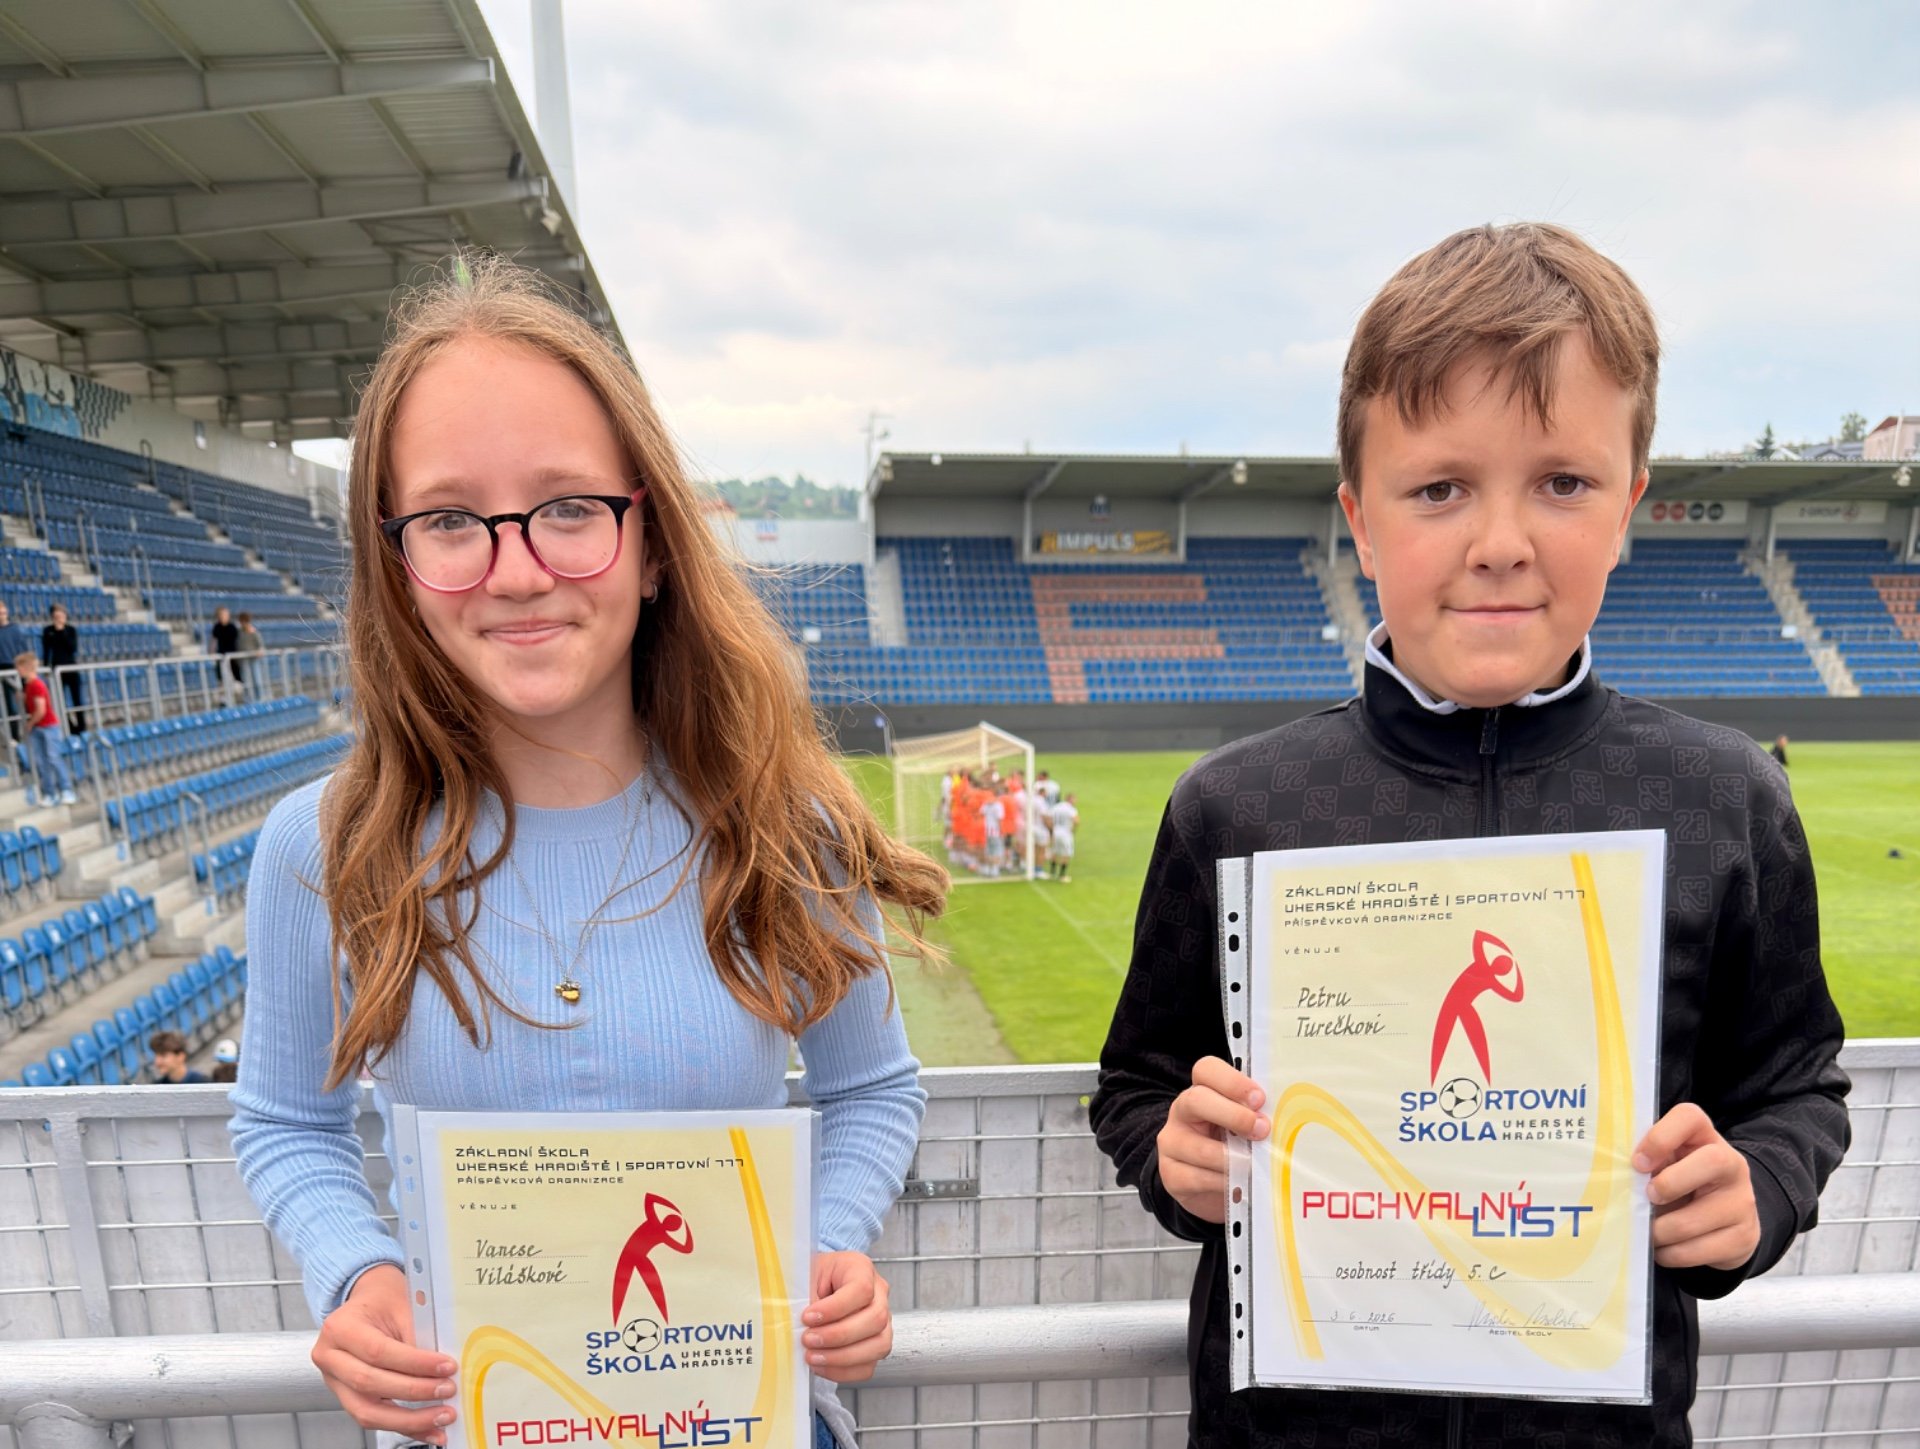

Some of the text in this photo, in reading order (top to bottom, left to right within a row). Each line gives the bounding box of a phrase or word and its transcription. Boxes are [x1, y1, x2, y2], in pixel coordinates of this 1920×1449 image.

[1057, 531, 1134, 550] IMPULS
[1285, 881, 1419, 898] ZÁKLADNÍ ŠKOLA
[1285, 898, 1356, 913] UHERSKÉ
[1362, 894, 1440, 911] HRADIŠTĚ
[1455, 888, 1548, 905] SPORTOVNÍ
[1553, 890, 1585, 900] 777
[1285, 912, 1453, 927] PŘÍSPĚVKOVÁ ORGANIZACE
[1284, 946, 1341, 955] VĚNUJE
[1297, 986, 1351, 1008] Petru
[1297, 1013, 1385, 1037] Turečkovi
[1399, 1116, 1497, 1142] ŠKOLA
[1502, 1117, 1586, 1128] UHERSKÉ
[1502, 1128, 1586, 1141] HRADIŠTĚ
[456, 1146, 589, 1157] ZÁKLADNÍ ŠKOLA
[456, 1160, 529, 1172] UHERSKÉ
[535, 1159, 611, 1172] HRADIŠTĚ
[625, 1157, 710, 1170] SPORTOVNÍ
[715, 1158, 744, 1168] 777
[457, 1175, 624, 1184] PŘÍSPĚVKOVÁ ORGANIZACE
[460, 1202, 517, 1210] VĚNUJE
[1303, 1180, 1531, 1220] POCHVALNÝ
[1472, 1206, 1594, 1238] LIST
[1336, 1261, 1397, 1280] osobnost
[1411, 1260, 1455, 1289] třídy
[1468, 1264, 1481, 1279] 5.
[681, 1346, 753, 1359] UHERSKÉ
[586, 1352, 677, 1376] ŠKOLA
[681, 1357, 753, 1369] HRADIŠTĚ
[496, 1400, 710, 1446] POCHVALNÝ
[659, 1416, 763, 1449] LIST
